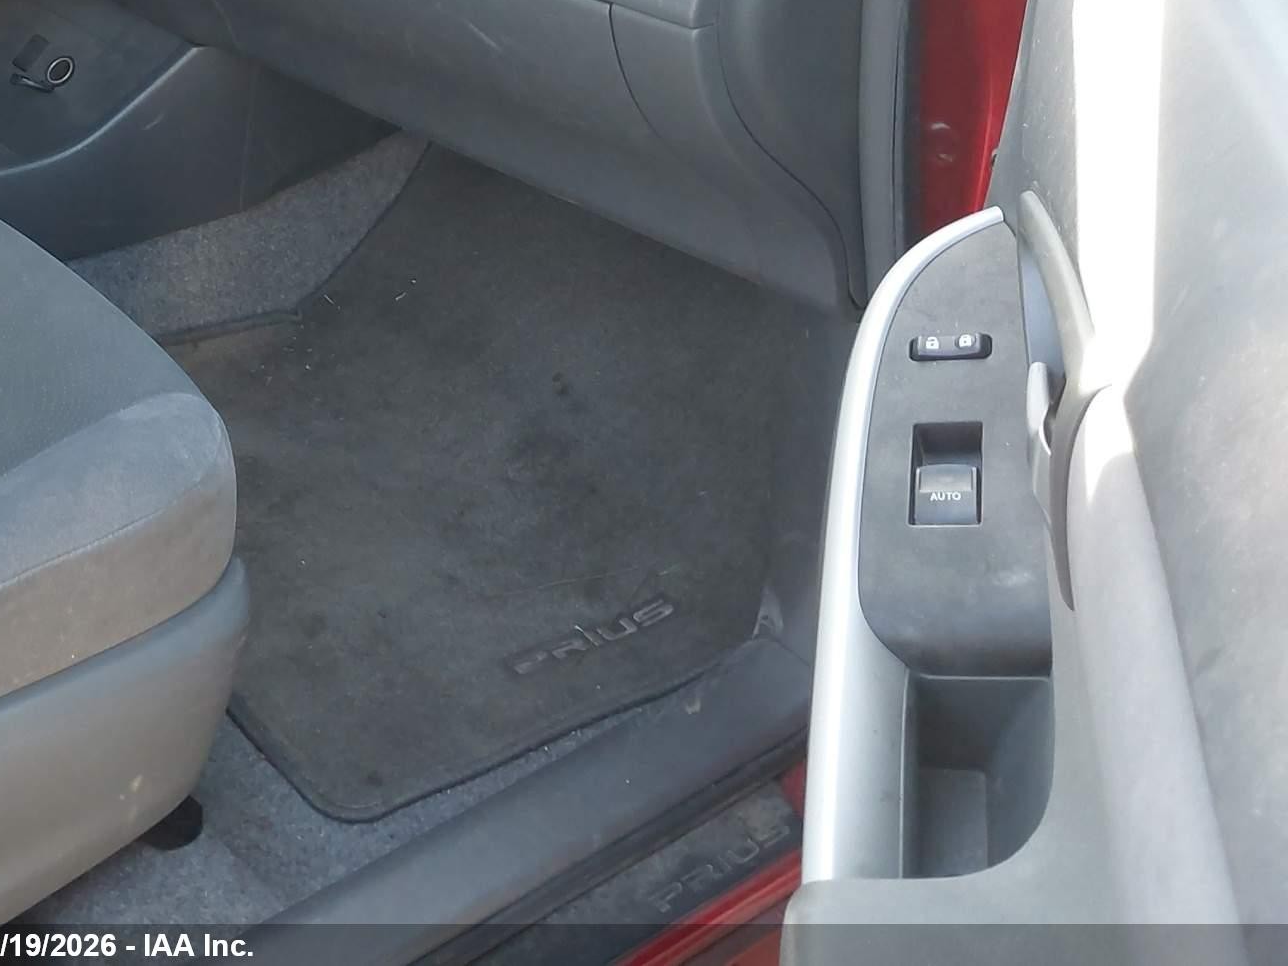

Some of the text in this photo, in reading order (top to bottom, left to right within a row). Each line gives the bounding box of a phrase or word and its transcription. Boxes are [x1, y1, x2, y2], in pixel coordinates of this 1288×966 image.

[929, 491, 962, 501] AUTO
[513, 599, 675, 675] PRIUS
[648, 825, 791, 913] PRIUS
